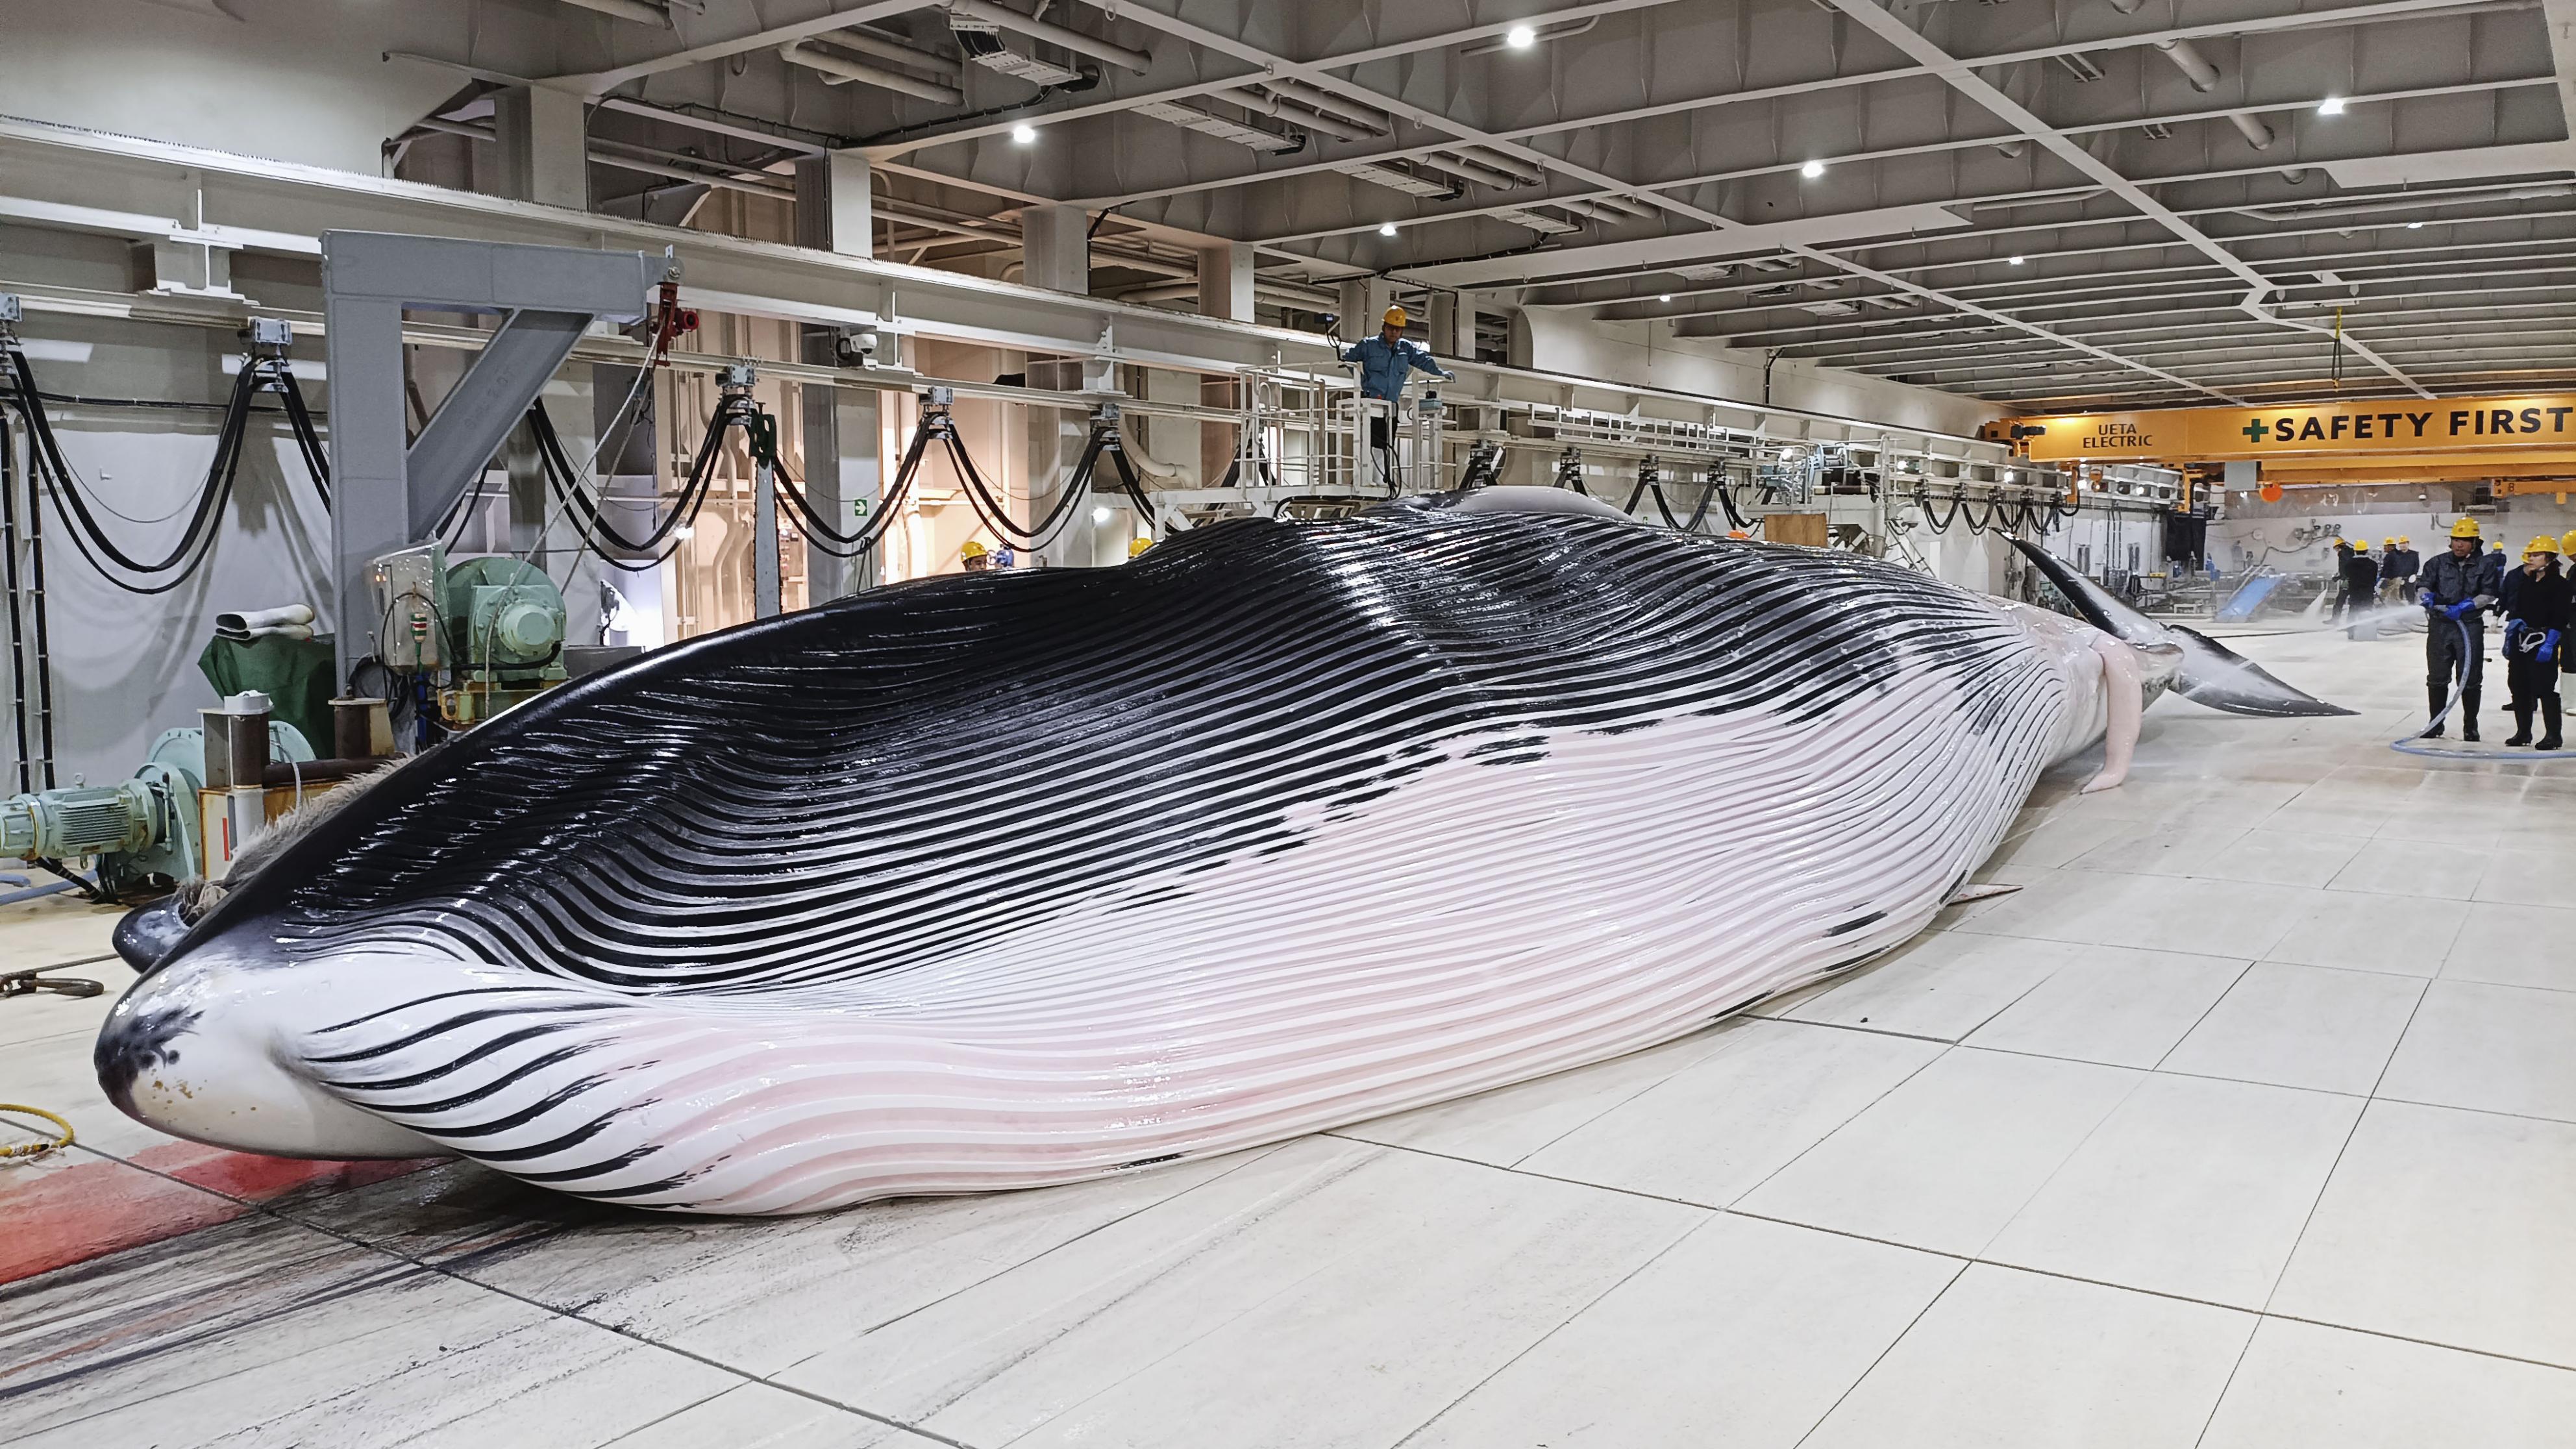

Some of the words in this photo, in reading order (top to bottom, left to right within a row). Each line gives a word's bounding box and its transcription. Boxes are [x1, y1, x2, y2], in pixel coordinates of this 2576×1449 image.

[2098, 423, 2137, 436] UETA
[2275, 412, 2433, 441] SAFETY
[2449, 406, 2573, 436] FIRST
[2083, 435, 2153, 449] ELECTRIC
